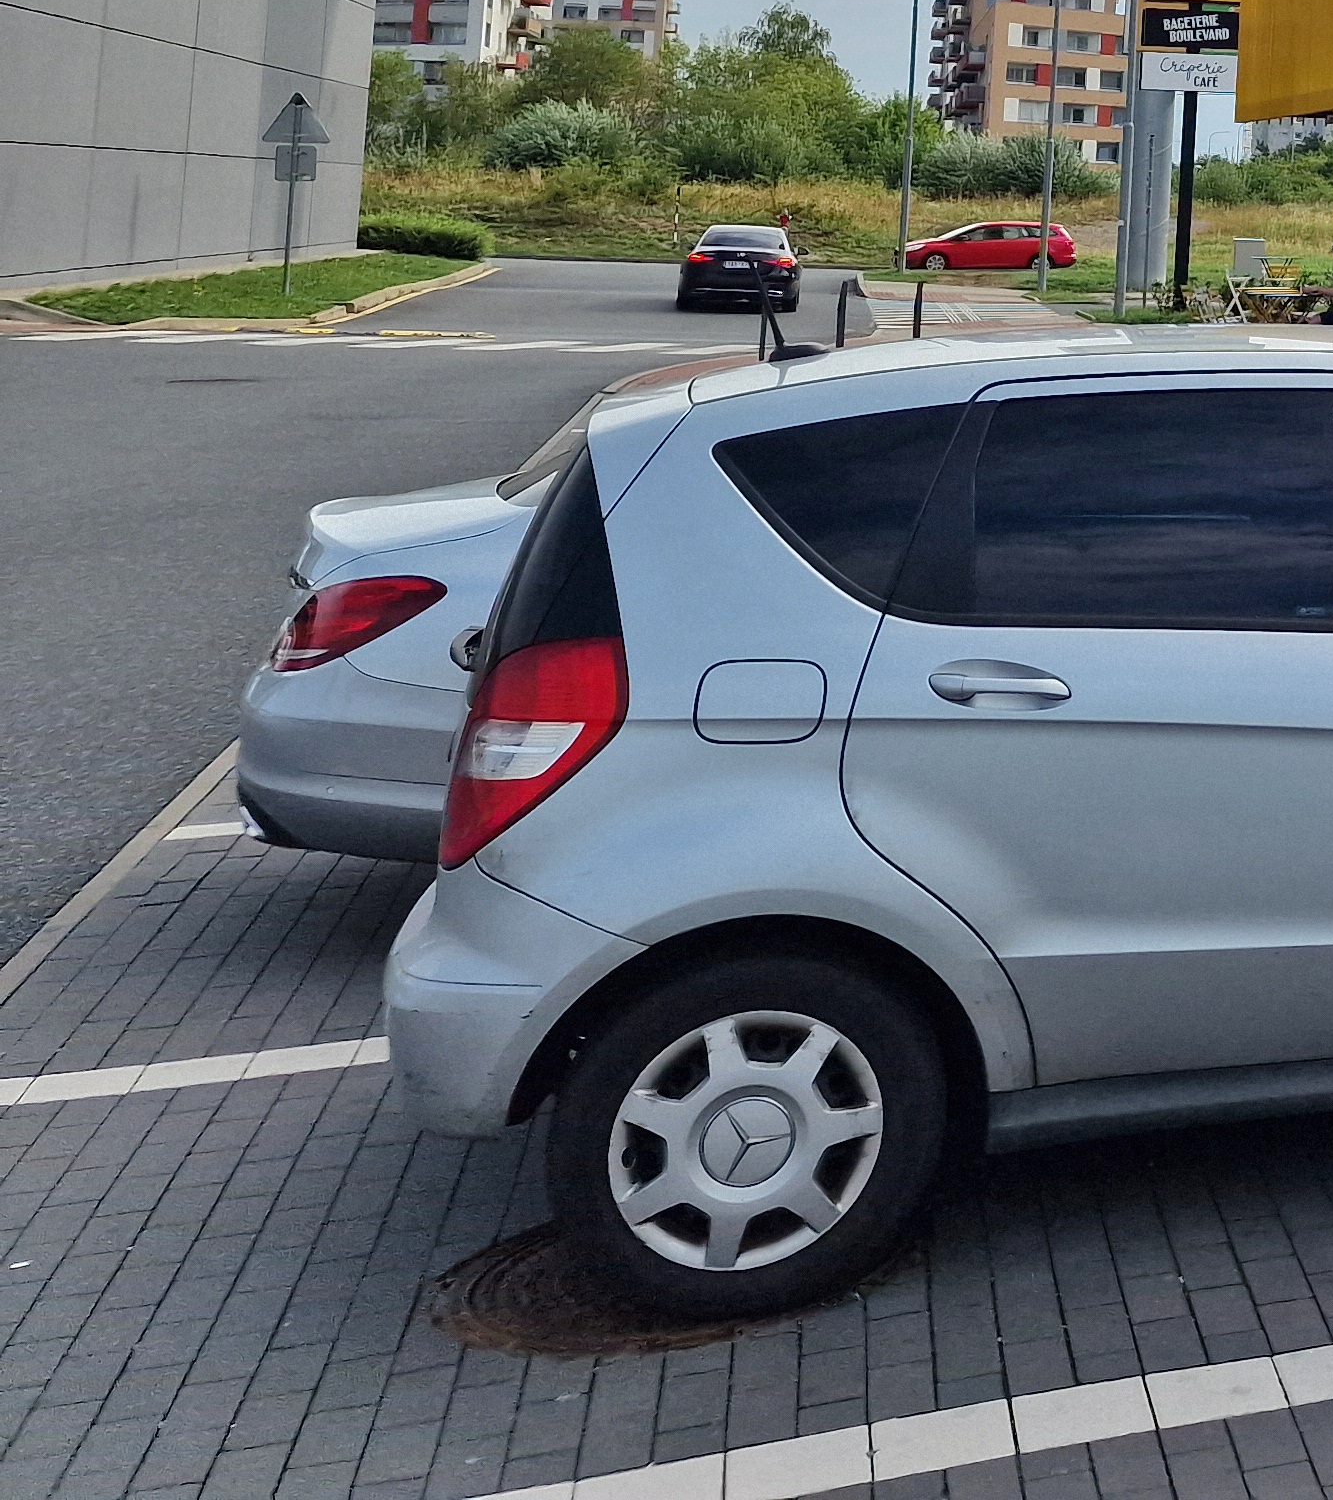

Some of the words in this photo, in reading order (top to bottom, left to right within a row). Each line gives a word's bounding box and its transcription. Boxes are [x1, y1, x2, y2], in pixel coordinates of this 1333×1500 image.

[1163, 14, 1219, 31] BAGETERIE
[1169, 28, 1230, 43] BOULEVARD
[1194, 74, 1218, 88] CAFÉ
